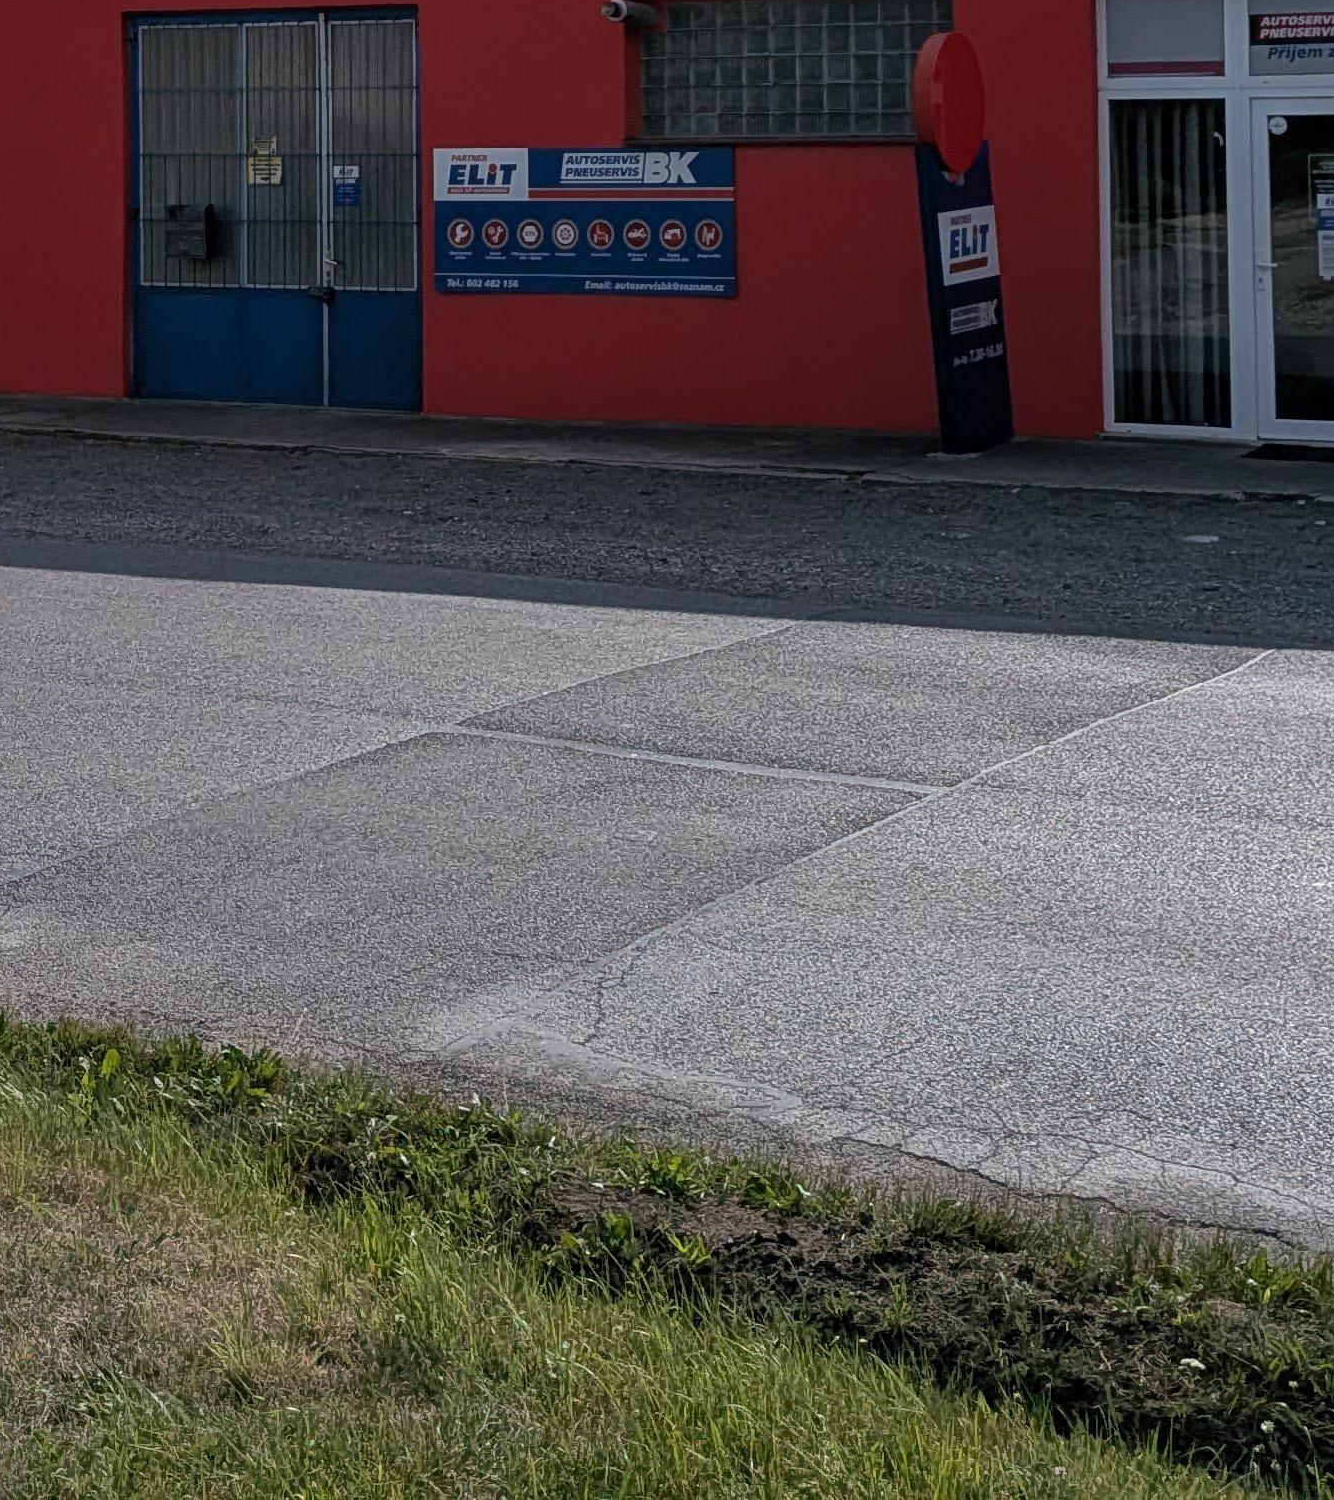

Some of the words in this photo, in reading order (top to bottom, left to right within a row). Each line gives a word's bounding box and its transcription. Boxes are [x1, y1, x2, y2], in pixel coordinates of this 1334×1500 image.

[451, 154, 487, 162] PARTNER
[565, 154, 640, 165] AUTOSERVIS
[565, 166, 640, 177] PNEUSERVIS
[643, 152, 699, 184] BK
